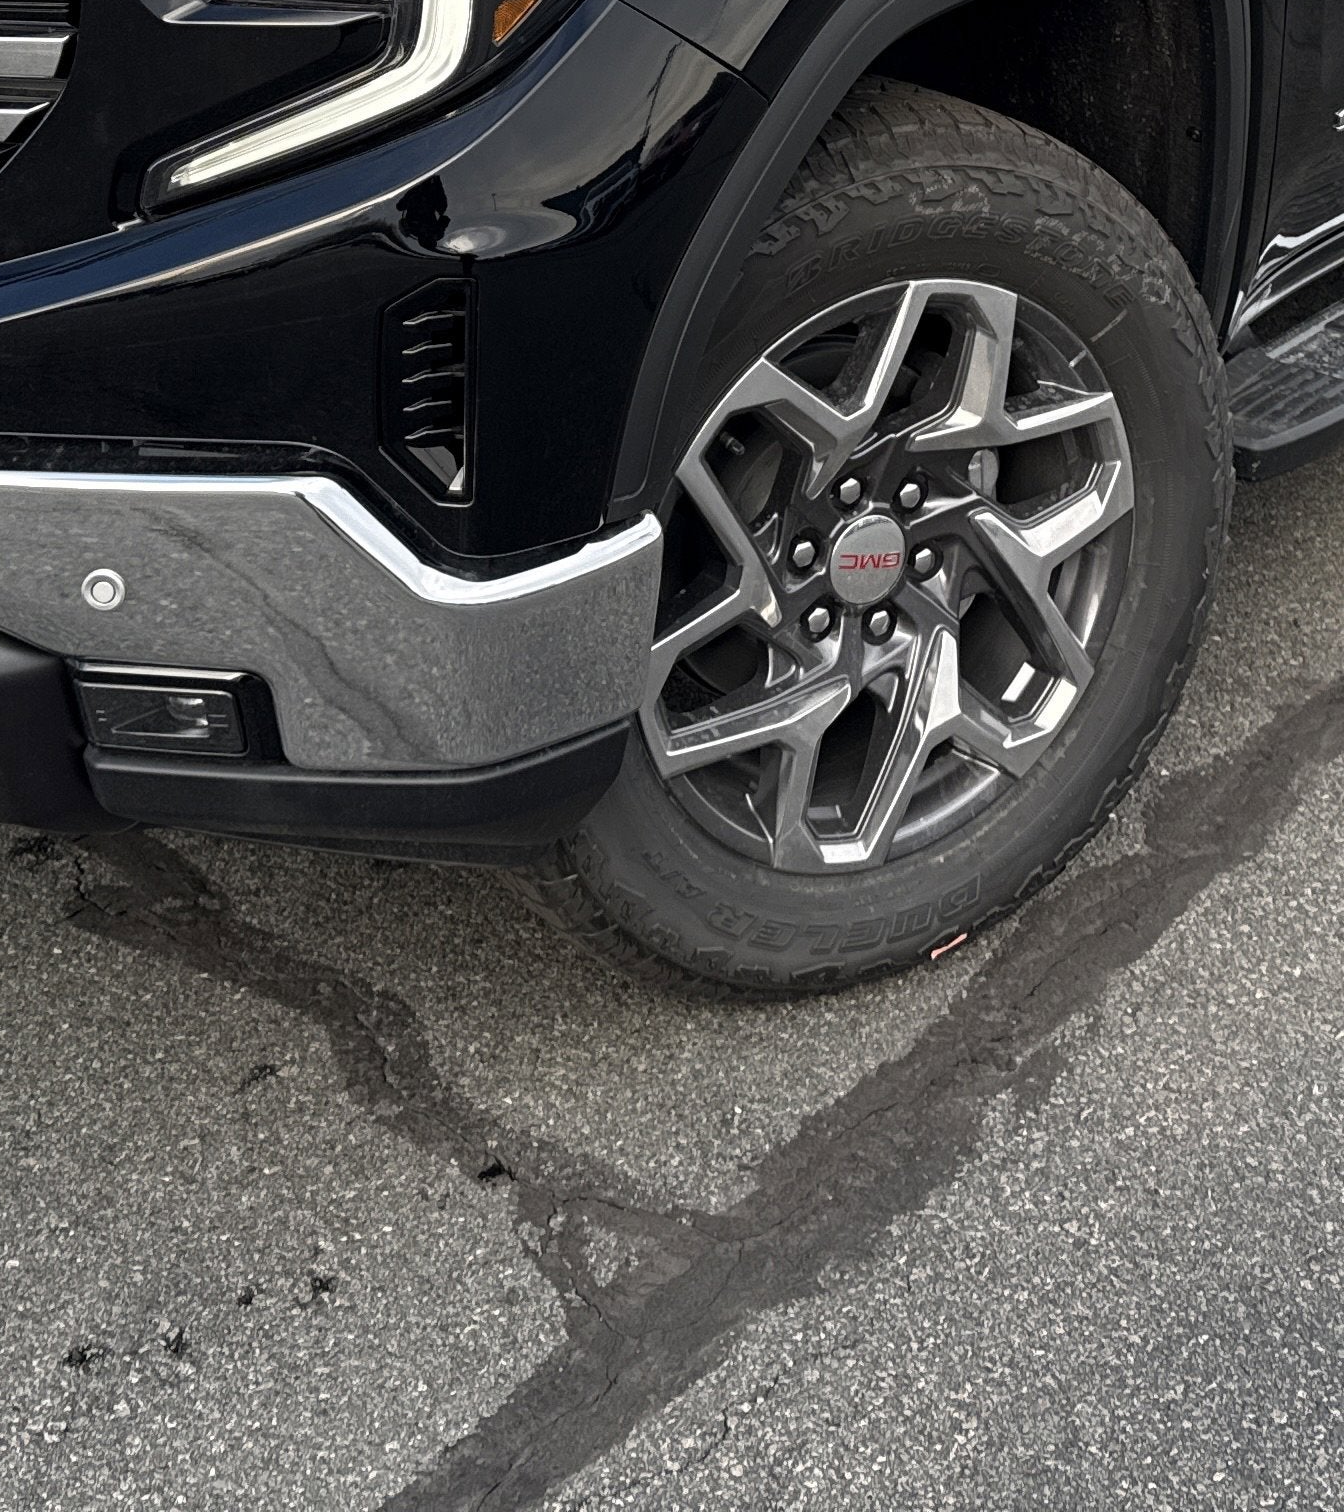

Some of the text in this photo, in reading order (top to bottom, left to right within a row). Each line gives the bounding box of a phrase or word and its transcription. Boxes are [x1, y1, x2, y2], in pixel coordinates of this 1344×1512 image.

[786, 212, 1138, 310] BRIDGESTONE
[838, 552, 901, 570] GMC
[705, 873, 983, 955] DUELER
